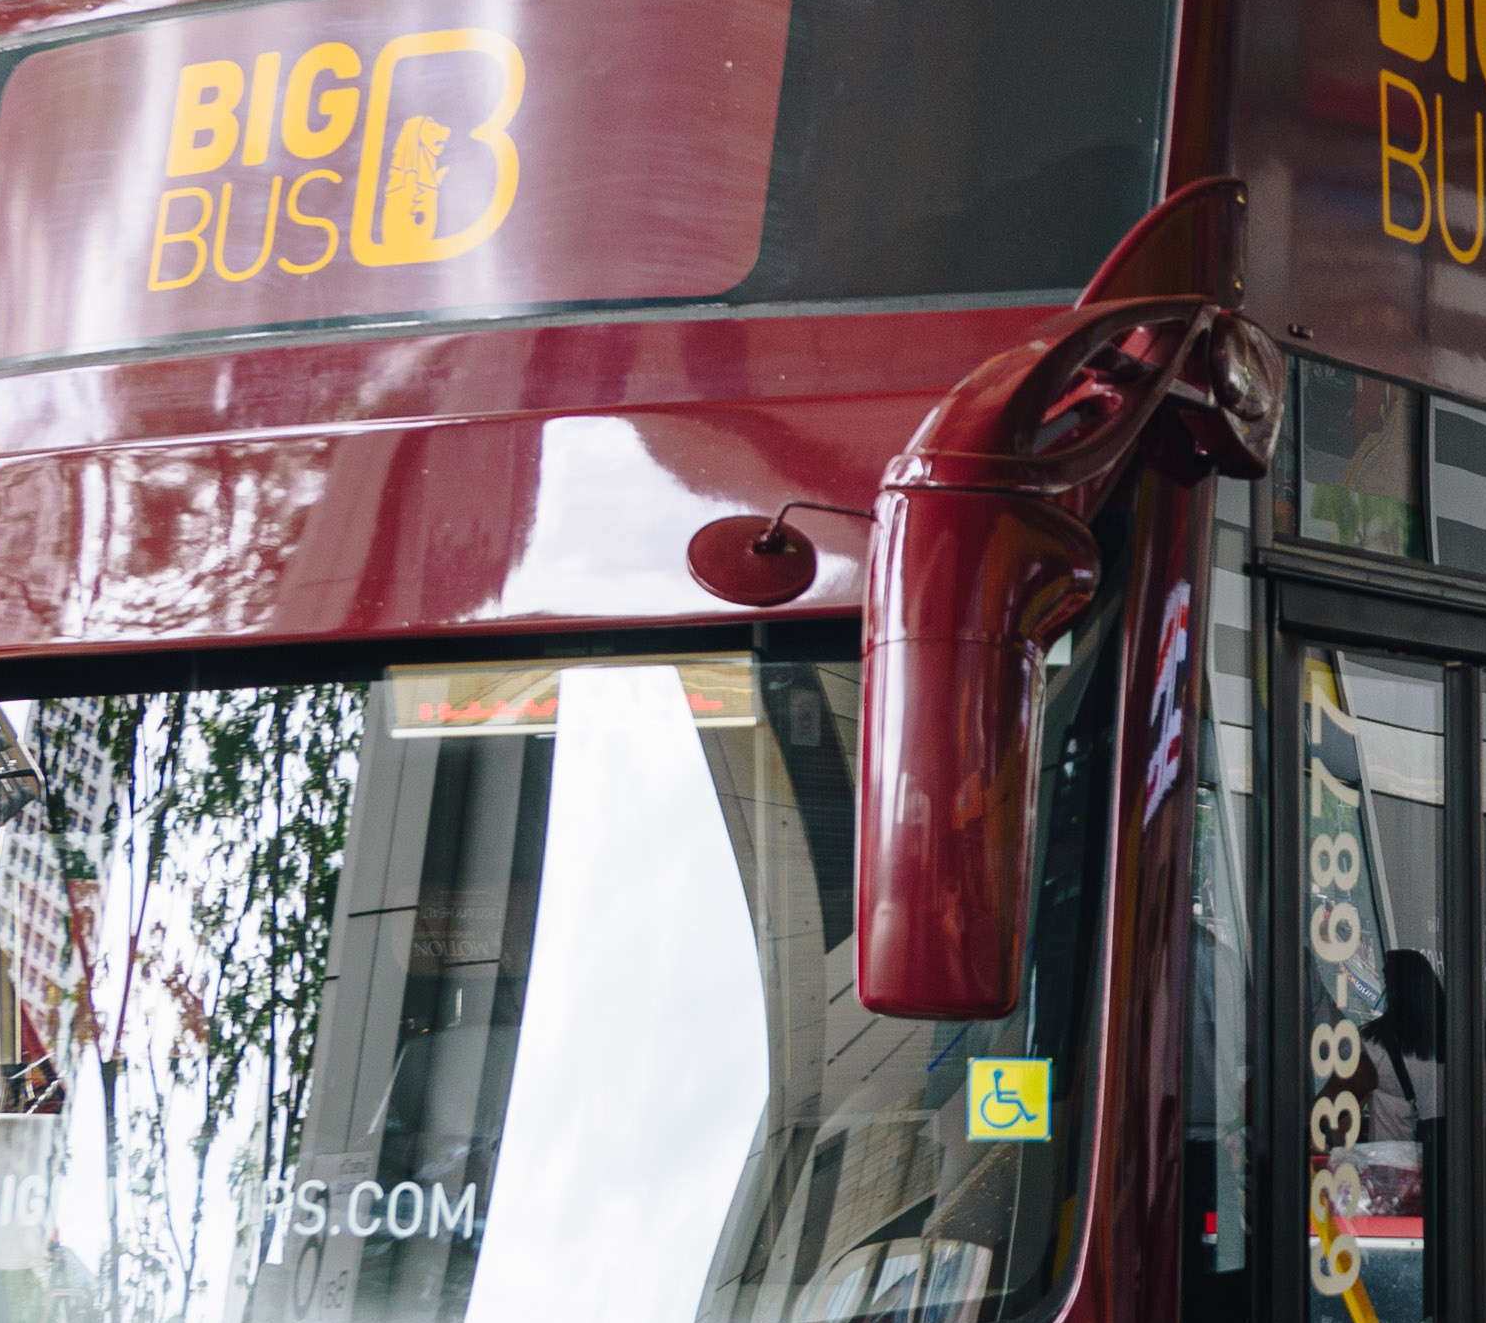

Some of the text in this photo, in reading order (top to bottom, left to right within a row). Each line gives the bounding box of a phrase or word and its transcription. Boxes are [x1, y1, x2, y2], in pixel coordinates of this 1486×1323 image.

[166, 41, 362, 178] BIG
[147, 169, 343, 292] BUS
[1309, 693, 1363, 1297] 6338-6877
